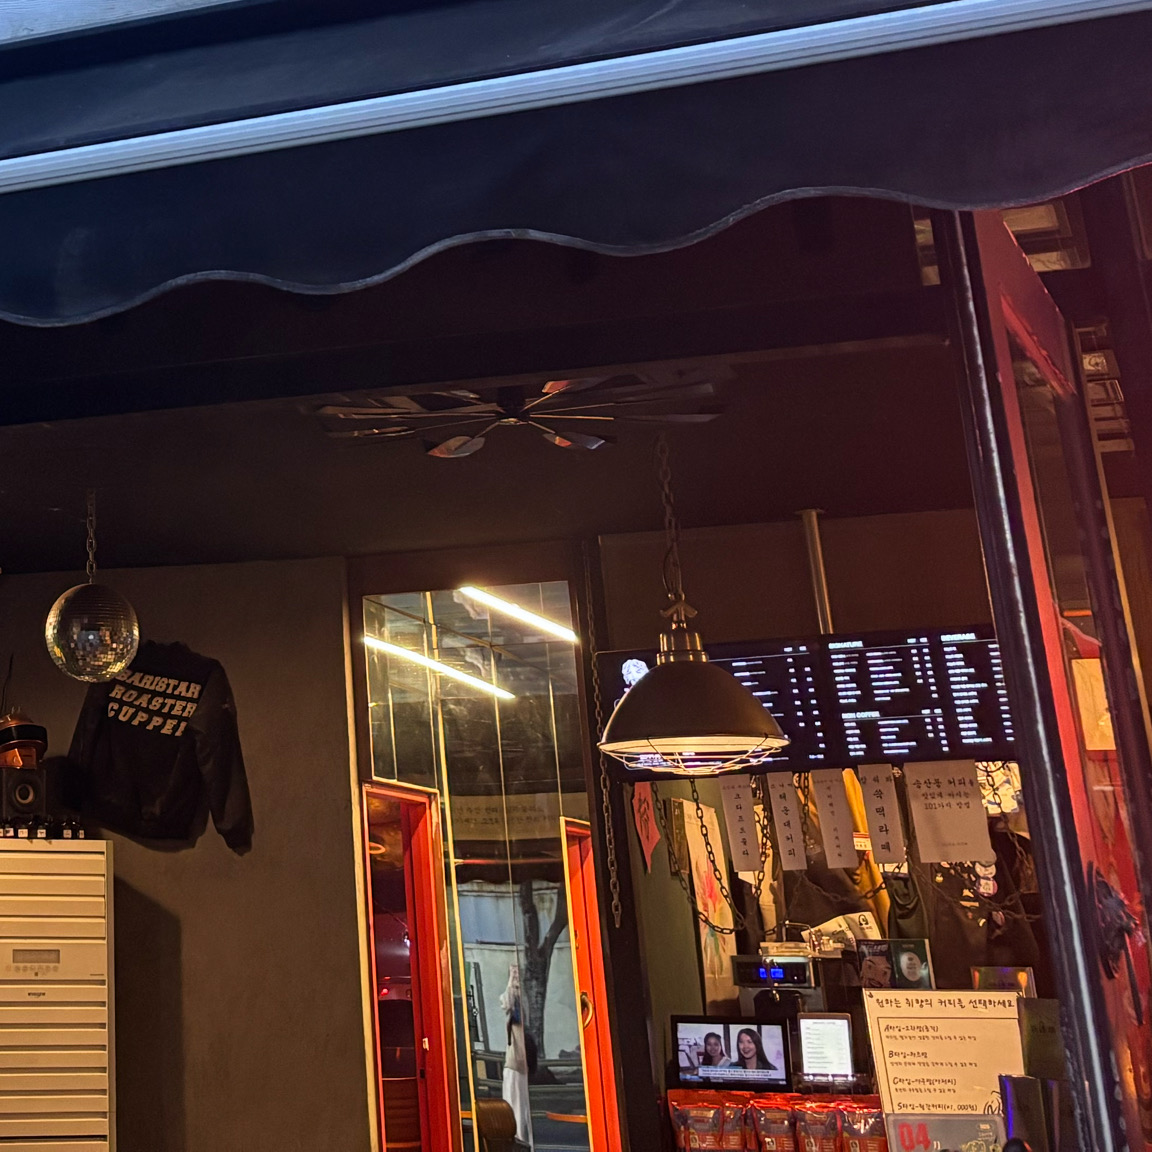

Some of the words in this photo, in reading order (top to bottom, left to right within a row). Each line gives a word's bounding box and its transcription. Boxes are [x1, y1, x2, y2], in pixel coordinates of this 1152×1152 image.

[109, 684, 198, 718] ROASTER
[876, 997, 902, 1009] 원하는
[905, 997, 933, 1009] 취향의
[937, 997, 966, 1009] 커피를
[968, 997, 1015, 1010] 선택하세요
